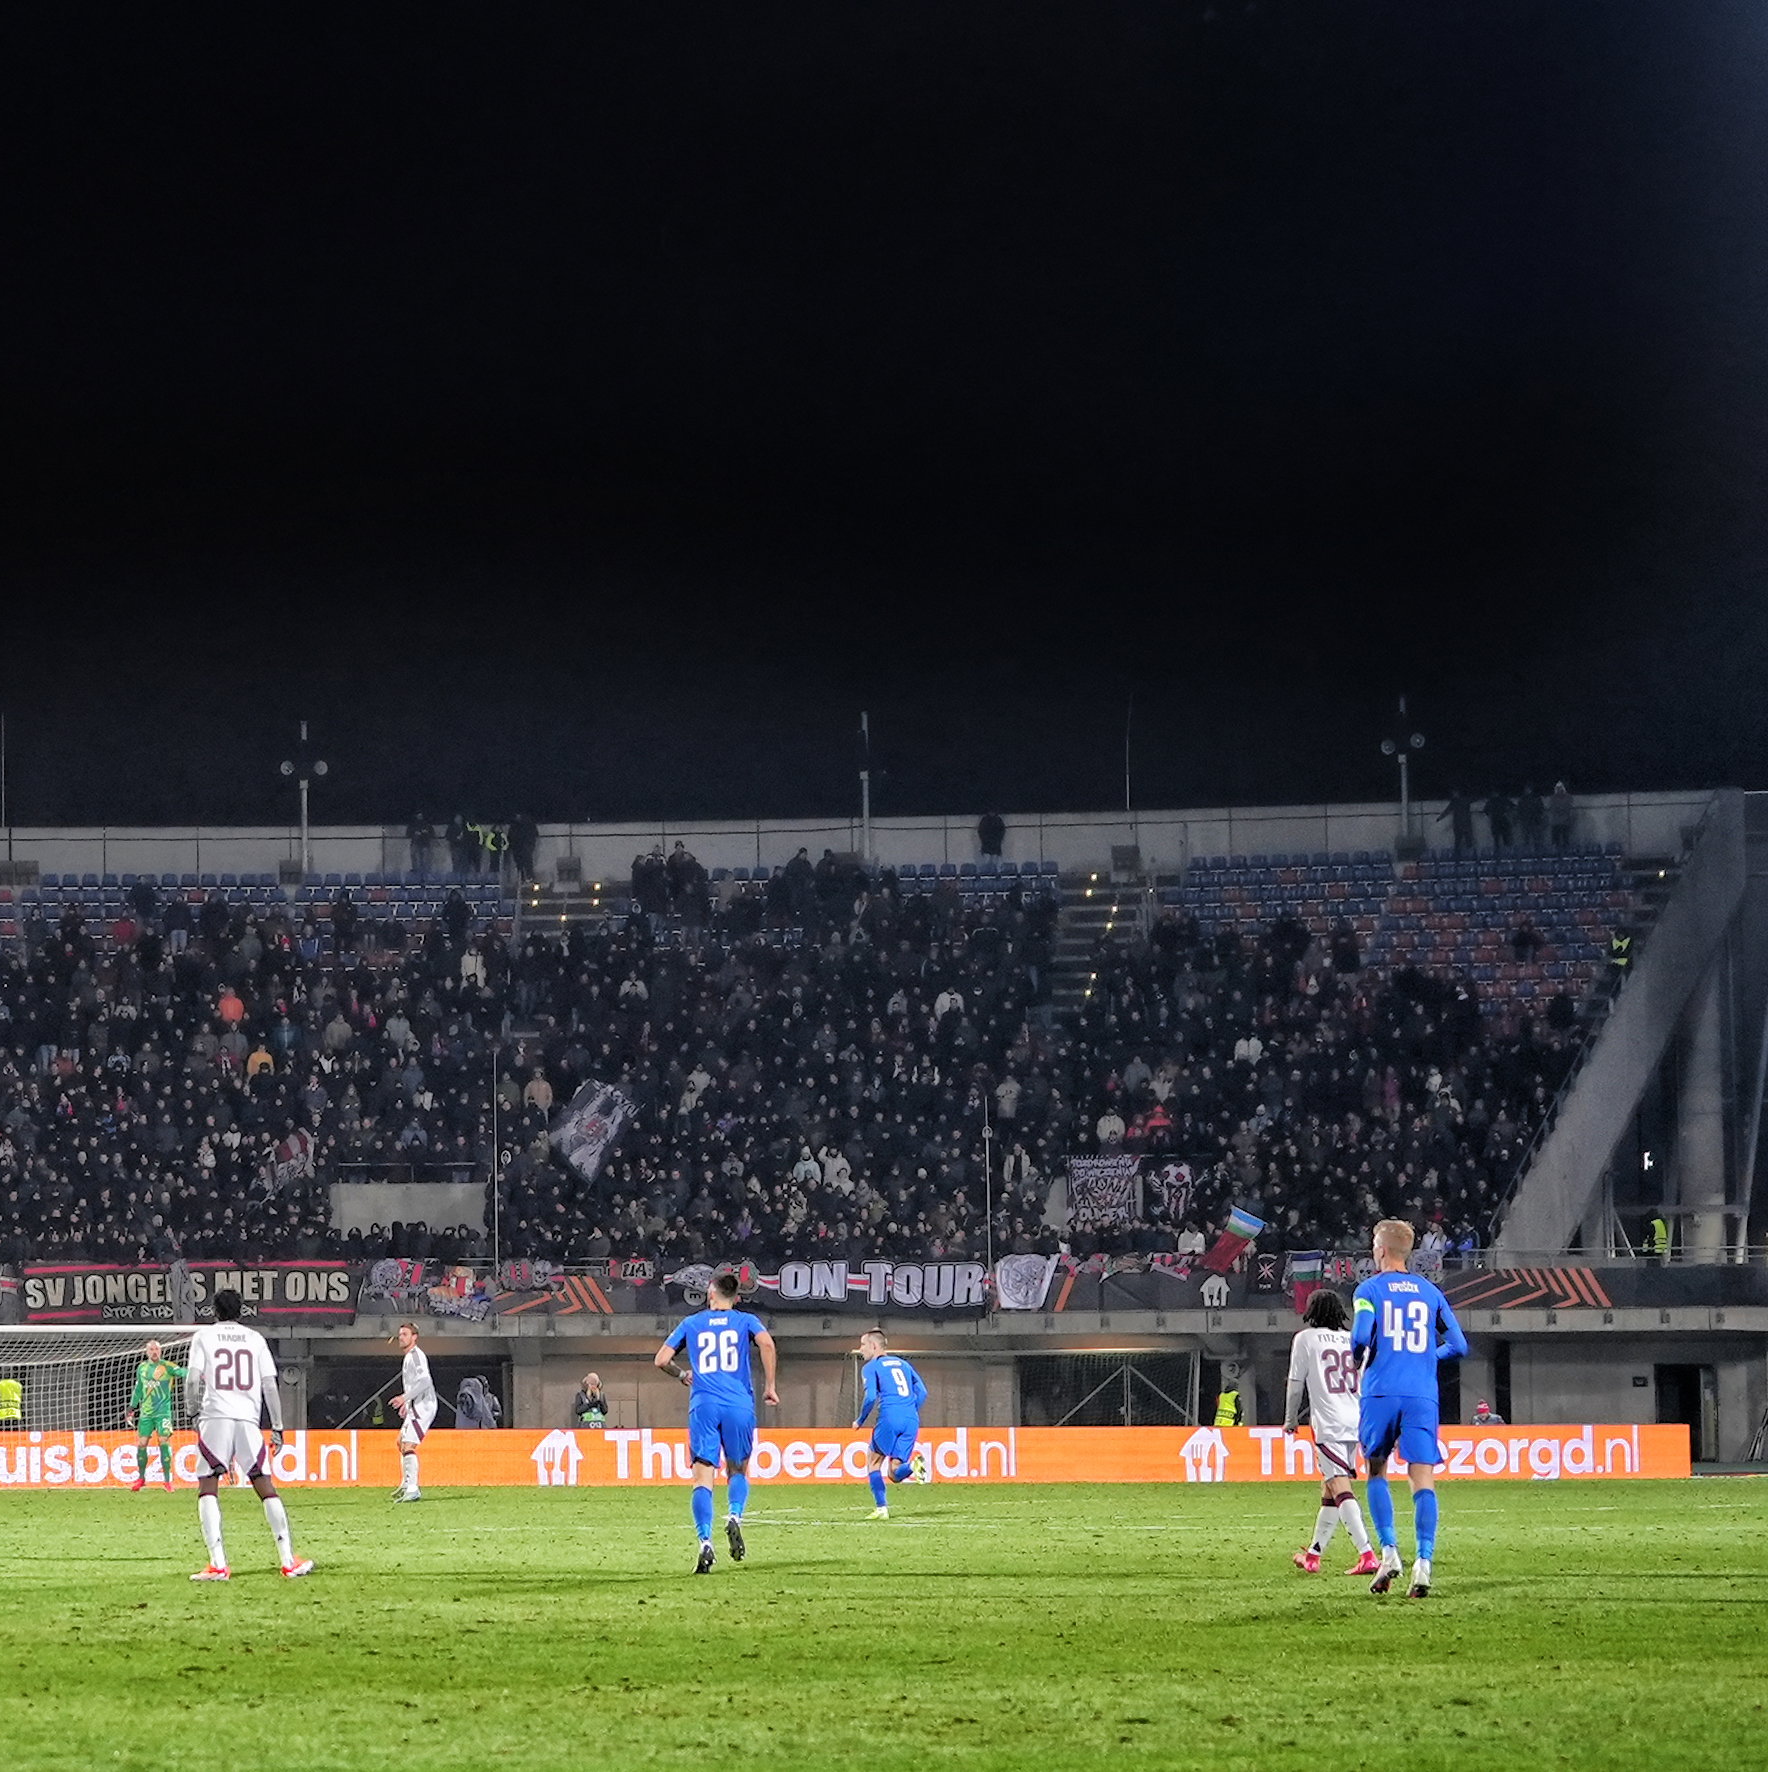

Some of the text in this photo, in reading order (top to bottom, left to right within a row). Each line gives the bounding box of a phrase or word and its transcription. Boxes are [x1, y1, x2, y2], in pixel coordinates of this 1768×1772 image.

[24, 1278, 66, 1309] SV
[214, 1271, 279, 1301] MET
[285, 1270, 350, 1302] ONS
[784, 1261, 984, 1305] ON TOUR
[102, 1304, 136, 1319] STOP
[1384, 1300, 1429, 1353] 43
[214, 1348, 253, 1391] 20
[697, 1330, 739, 1374] 26
[1322, 1349, 1358, 1393] 28
[891, 1367, 910, 1397] 9
